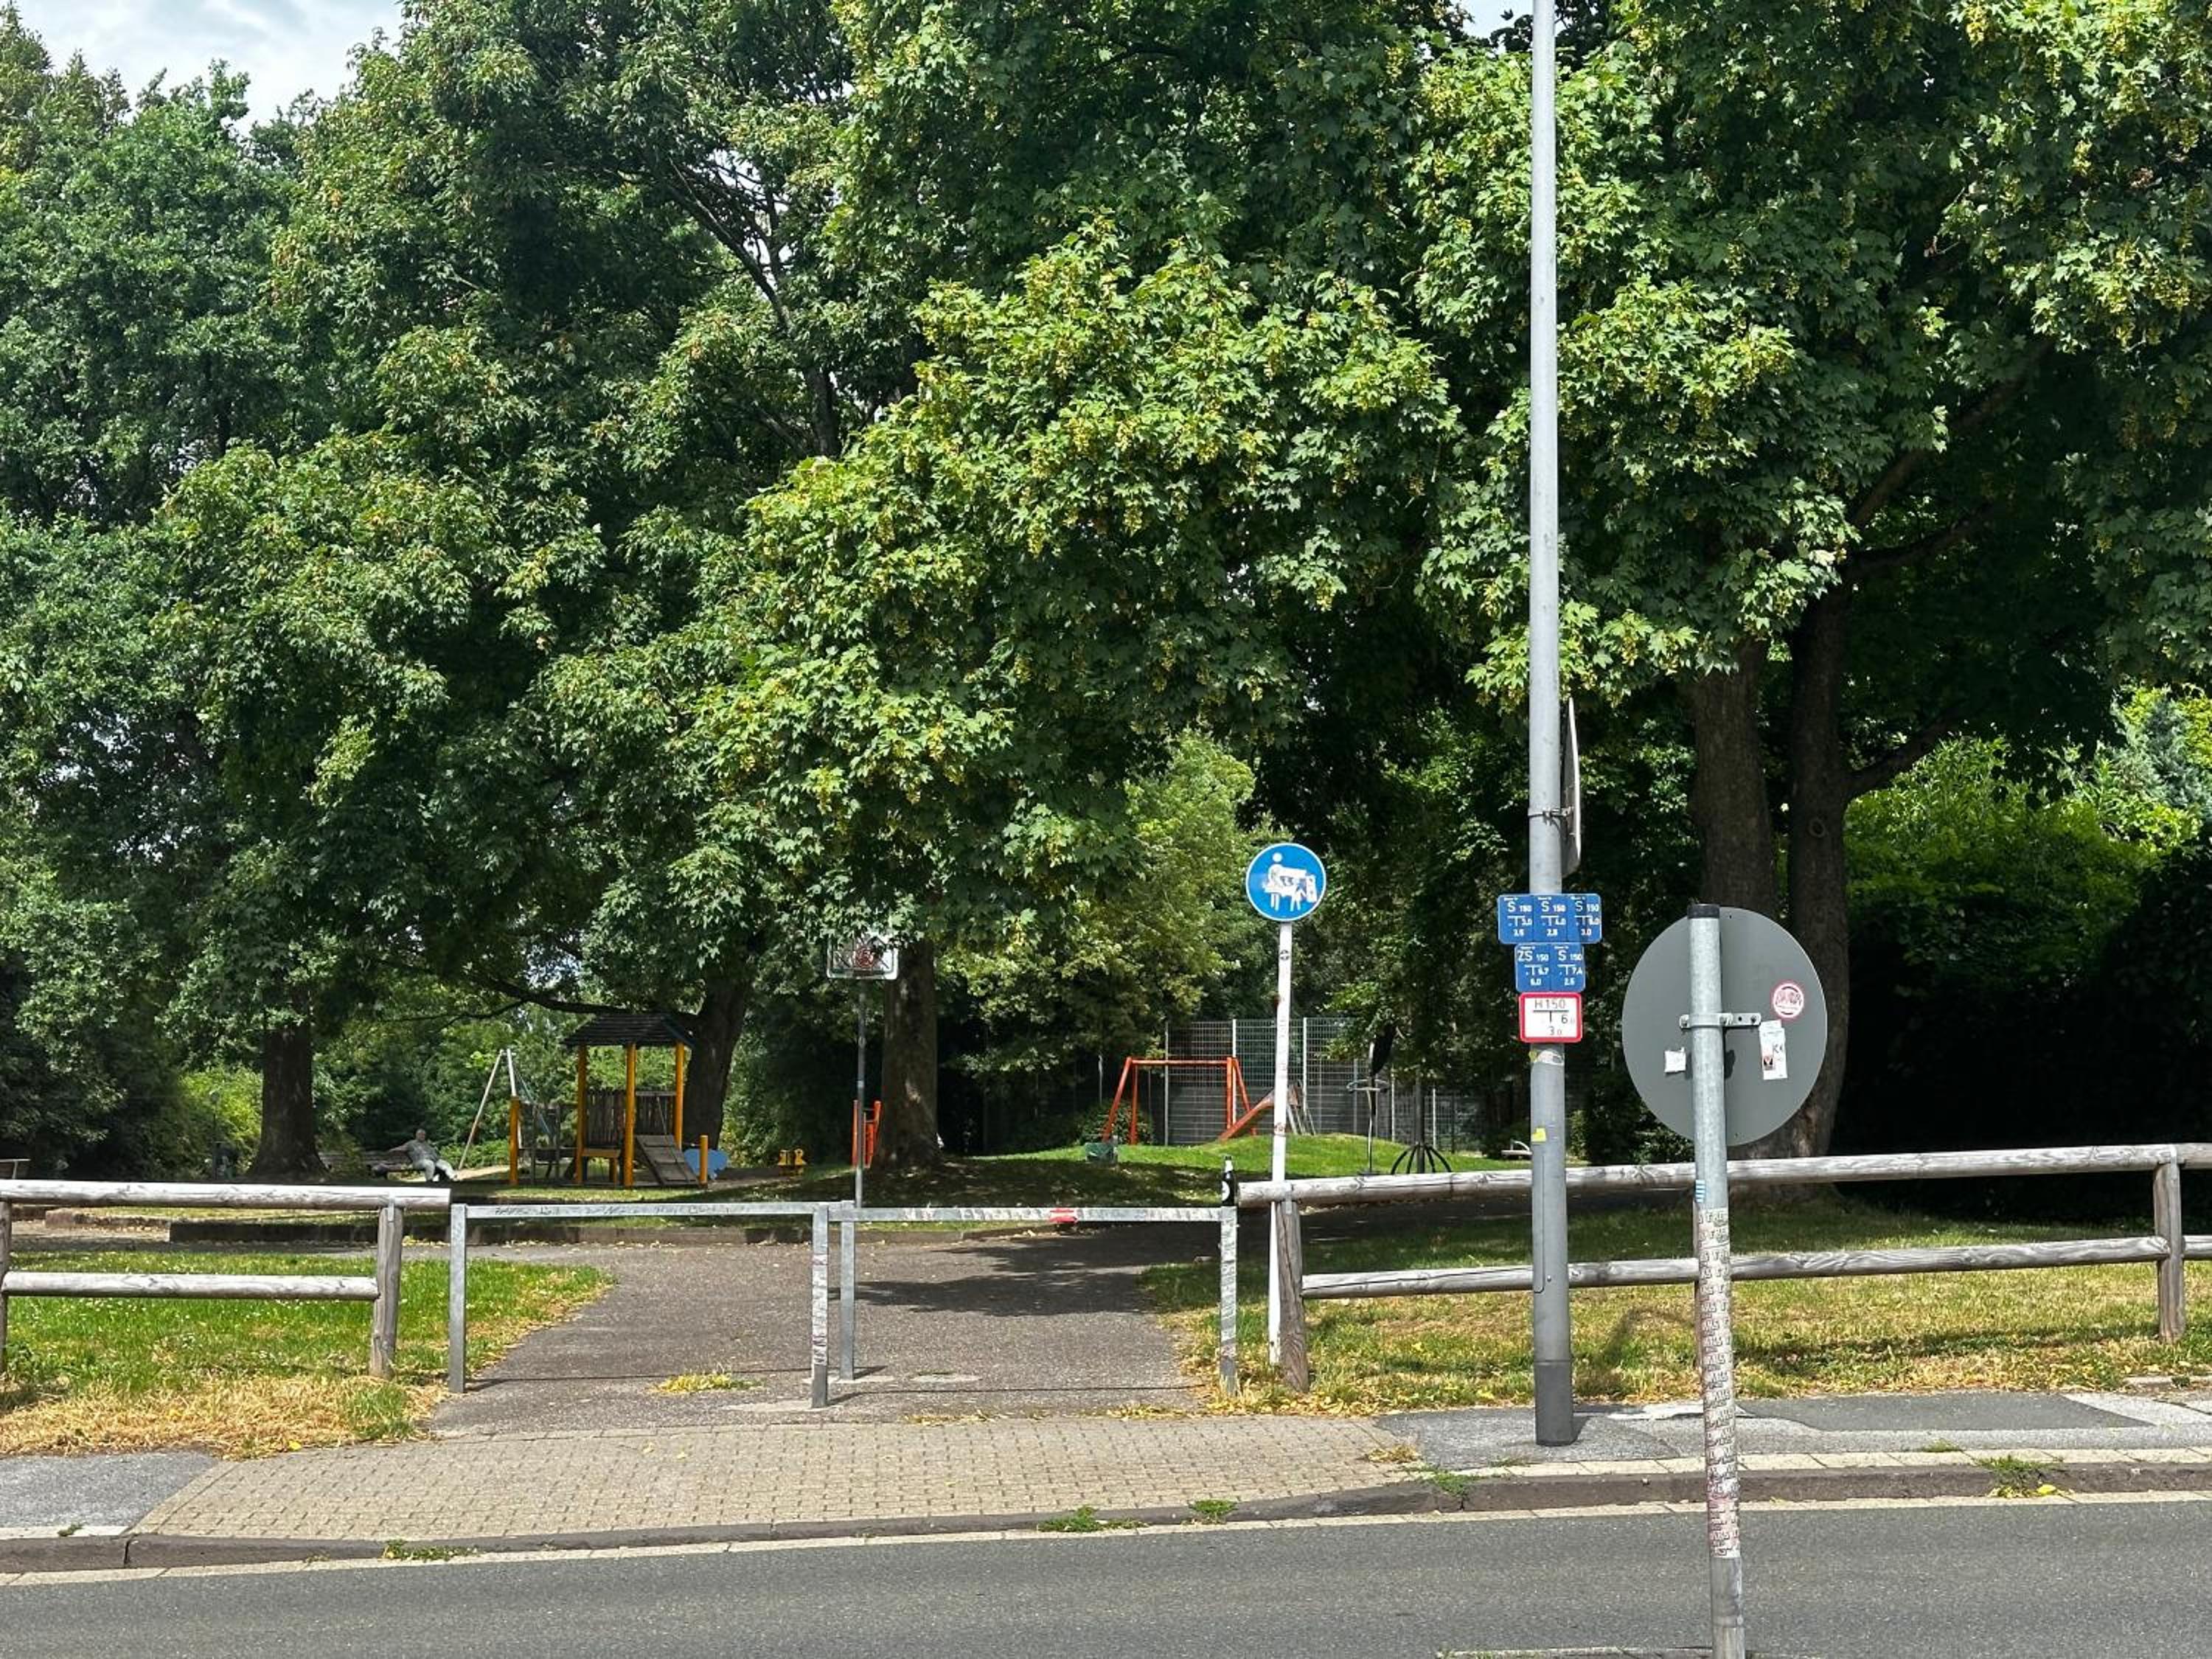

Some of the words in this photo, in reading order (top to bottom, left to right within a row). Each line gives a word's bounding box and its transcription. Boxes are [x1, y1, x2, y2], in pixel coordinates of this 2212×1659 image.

[1508, 901, 1516, 912] S
[1541, 901, 1549, 912] S
[1575, 900, 1583, 911] S
[1517, 950, 1533, 961] ZS
[1558, 950, 1567, 961] S
